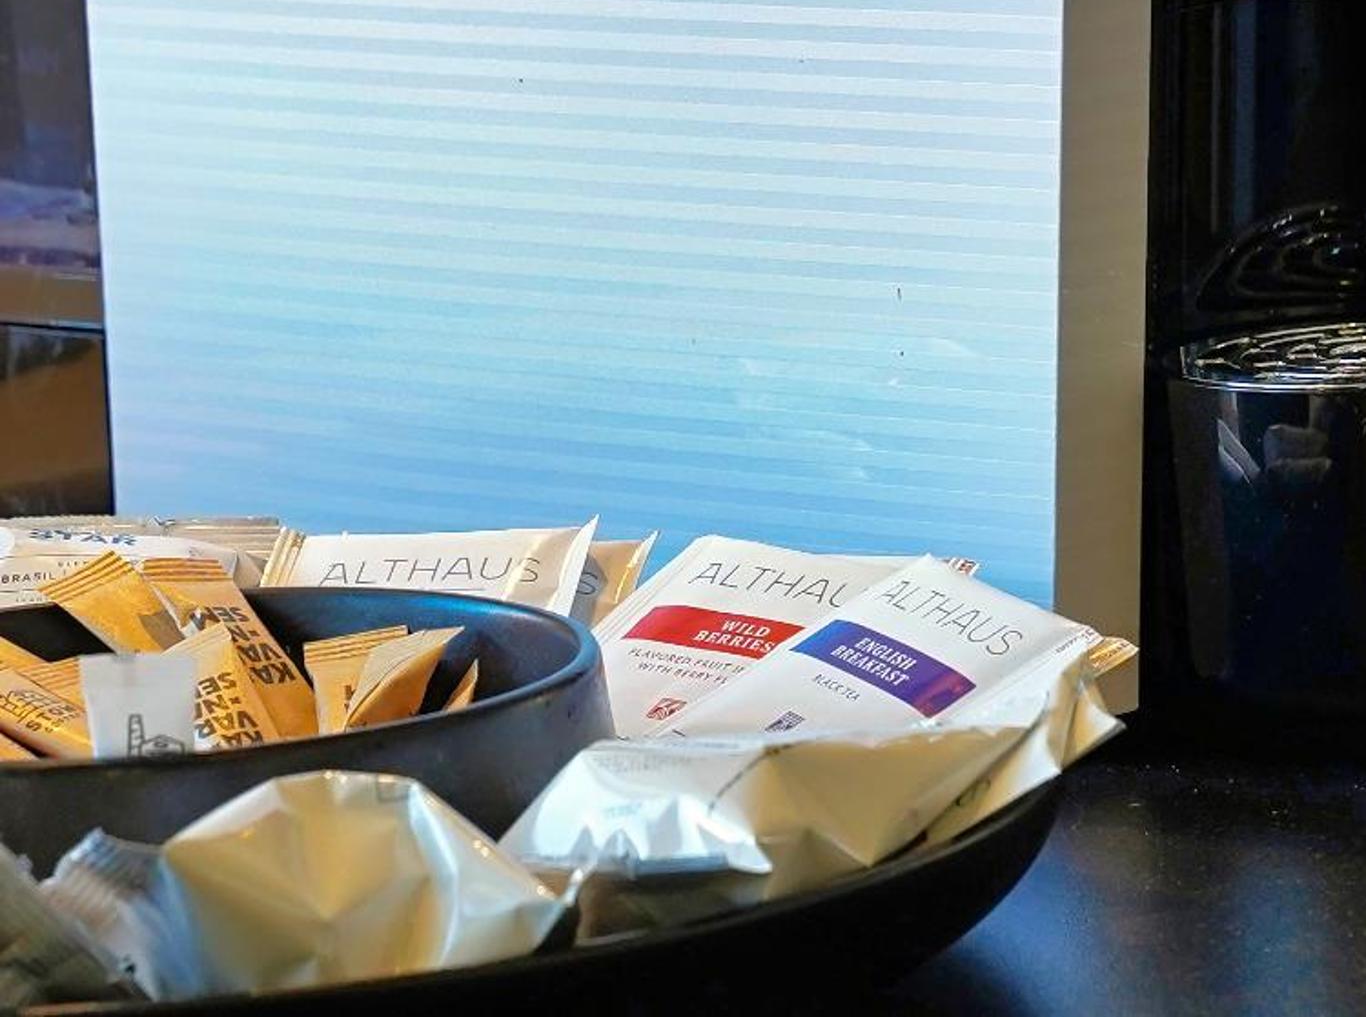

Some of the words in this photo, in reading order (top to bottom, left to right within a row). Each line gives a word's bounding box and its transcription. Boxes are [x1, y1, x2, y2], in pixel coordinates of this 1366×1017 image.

[1, 571, 57, 584] BRASIL
[319, 557, 541, 588] ALTHAUS
[688, 562, 868, 608] ALTHAU
[720, 619, 771, 637] WILD
[880, 580, 1024, 656] ALTHAUS
[693, 629, 776, 654] BERRIES
[853, 637, 918, 672] ENGLISH
[830, 644, 911, 687] BREAKFAST
